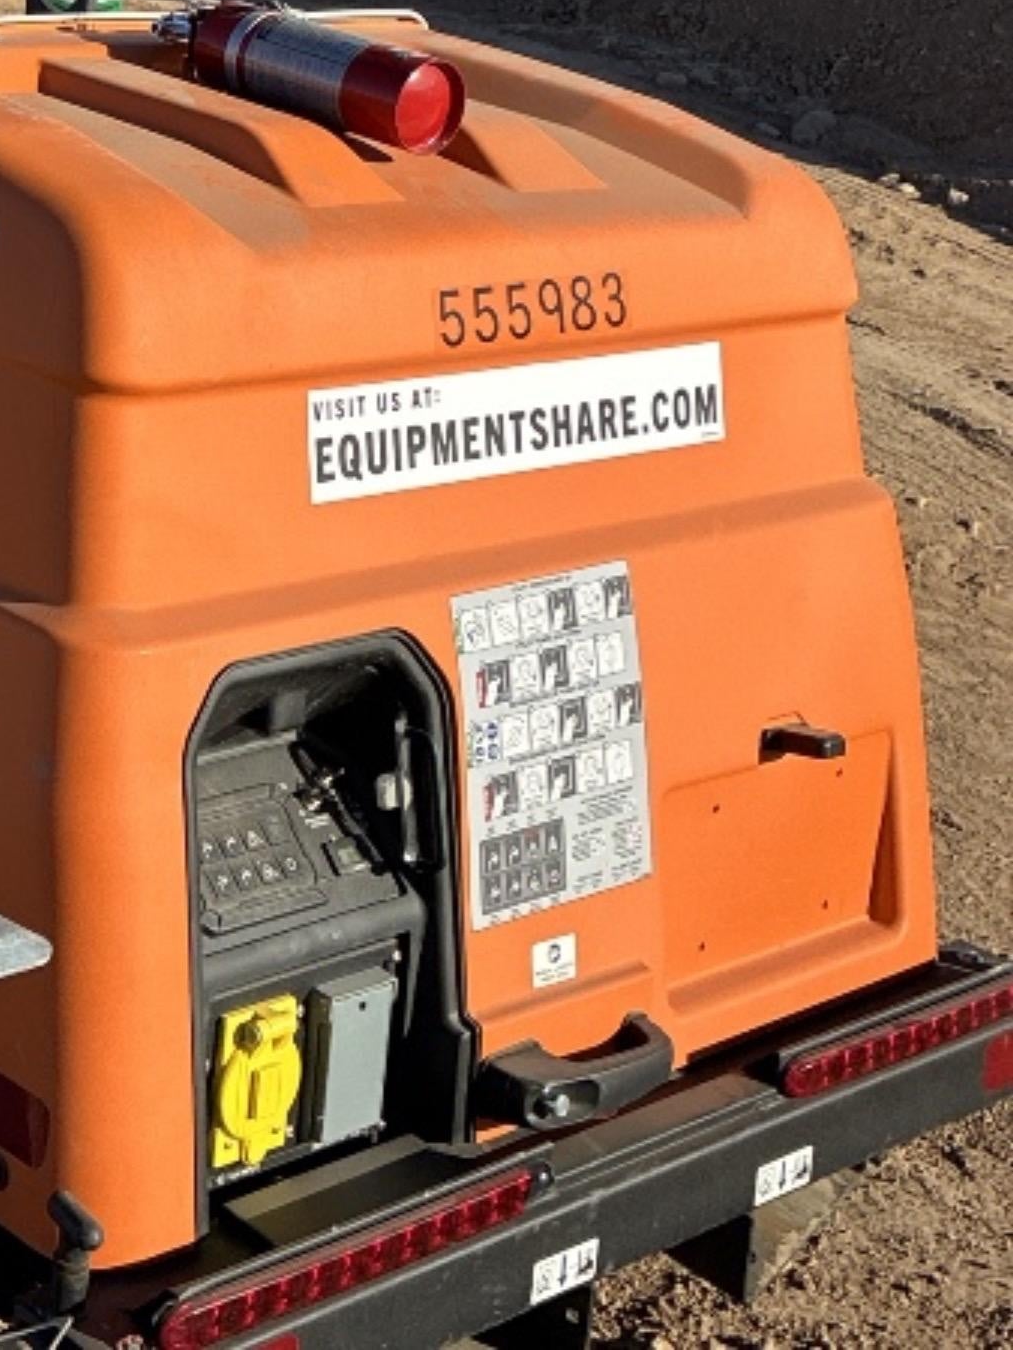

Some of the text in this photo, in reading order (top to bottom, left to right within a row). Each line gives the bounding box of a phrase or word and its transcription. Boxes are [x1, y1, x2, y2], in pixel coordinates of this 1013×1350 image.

[438, 272, 628, 348] 555983
[313, 386, 441, 422] VISIT US AT:
[315, 383, 719, 482] EQUIPMENTSHARE.COM
